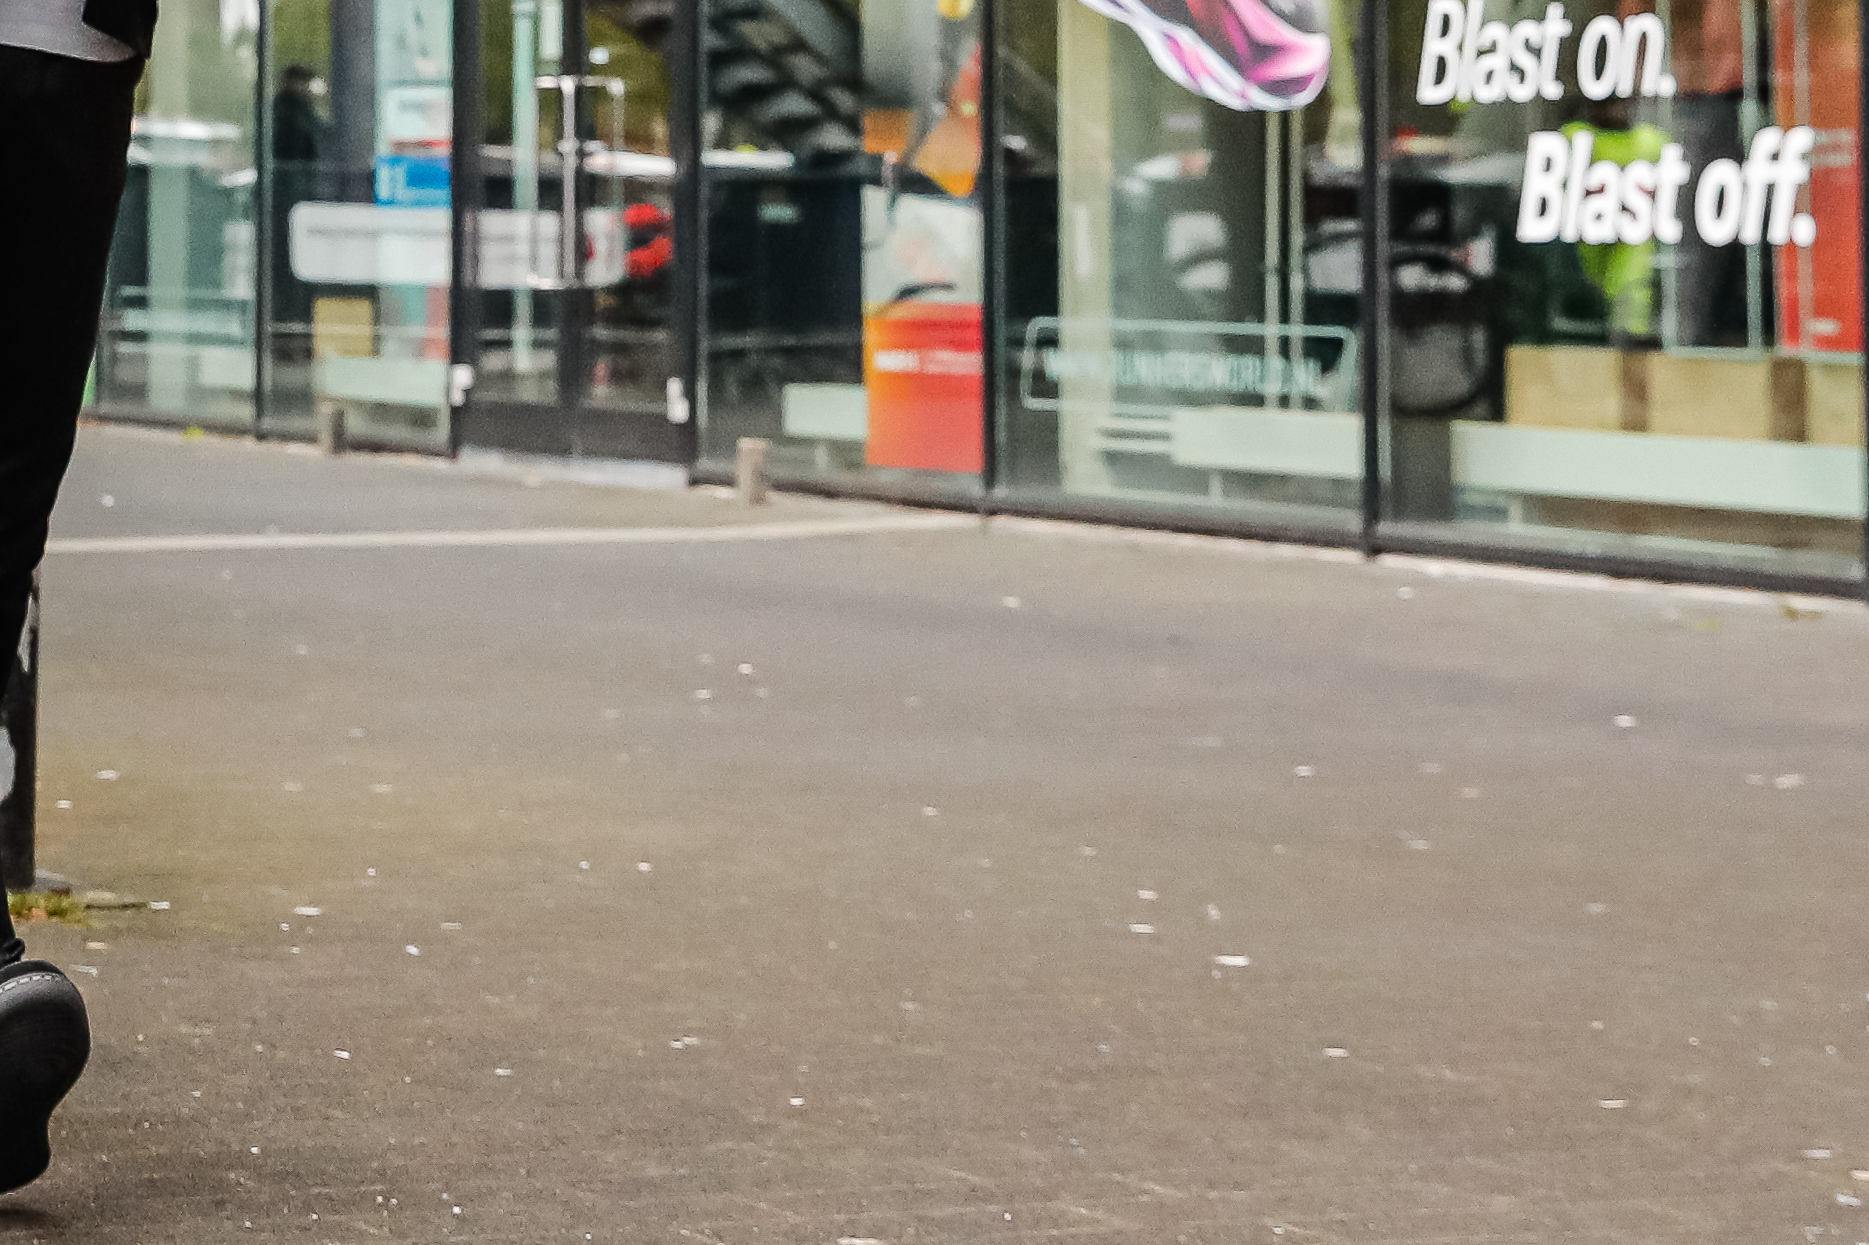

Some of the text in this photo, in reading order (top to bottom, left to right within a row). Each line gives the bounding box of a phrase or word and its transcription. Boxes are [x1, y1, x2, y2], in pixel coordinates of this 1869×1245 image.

[1577, 11, 1678, 101] on.
[1516, 124, 1818, 247] Blast off.
